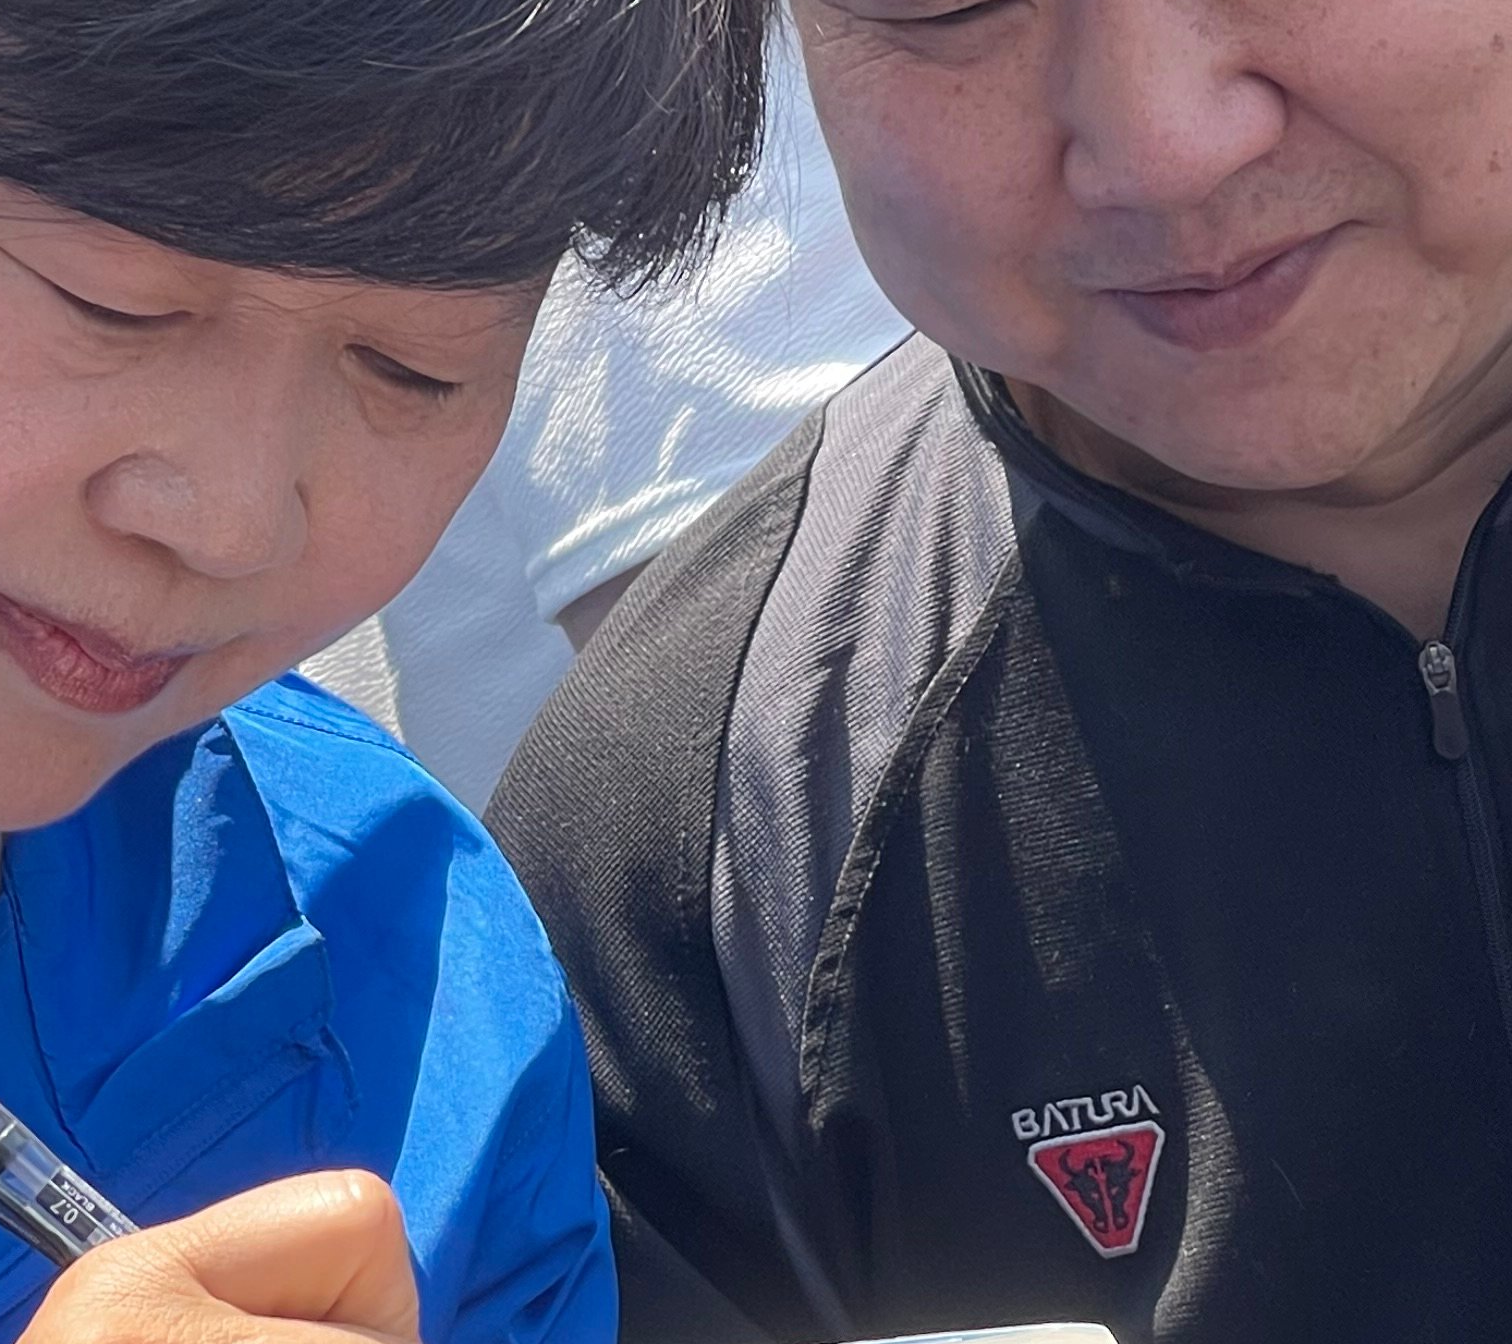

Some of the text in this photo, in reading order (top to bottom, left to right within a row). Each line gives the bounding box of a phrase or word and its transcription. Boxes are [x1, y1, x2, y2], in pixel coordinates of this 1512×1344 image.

[1011, 1084, 1160, 1140] BATURA
[49, 1197, 80, 1225] 0.7
[59, 1179, 96, 1212] BLACK
